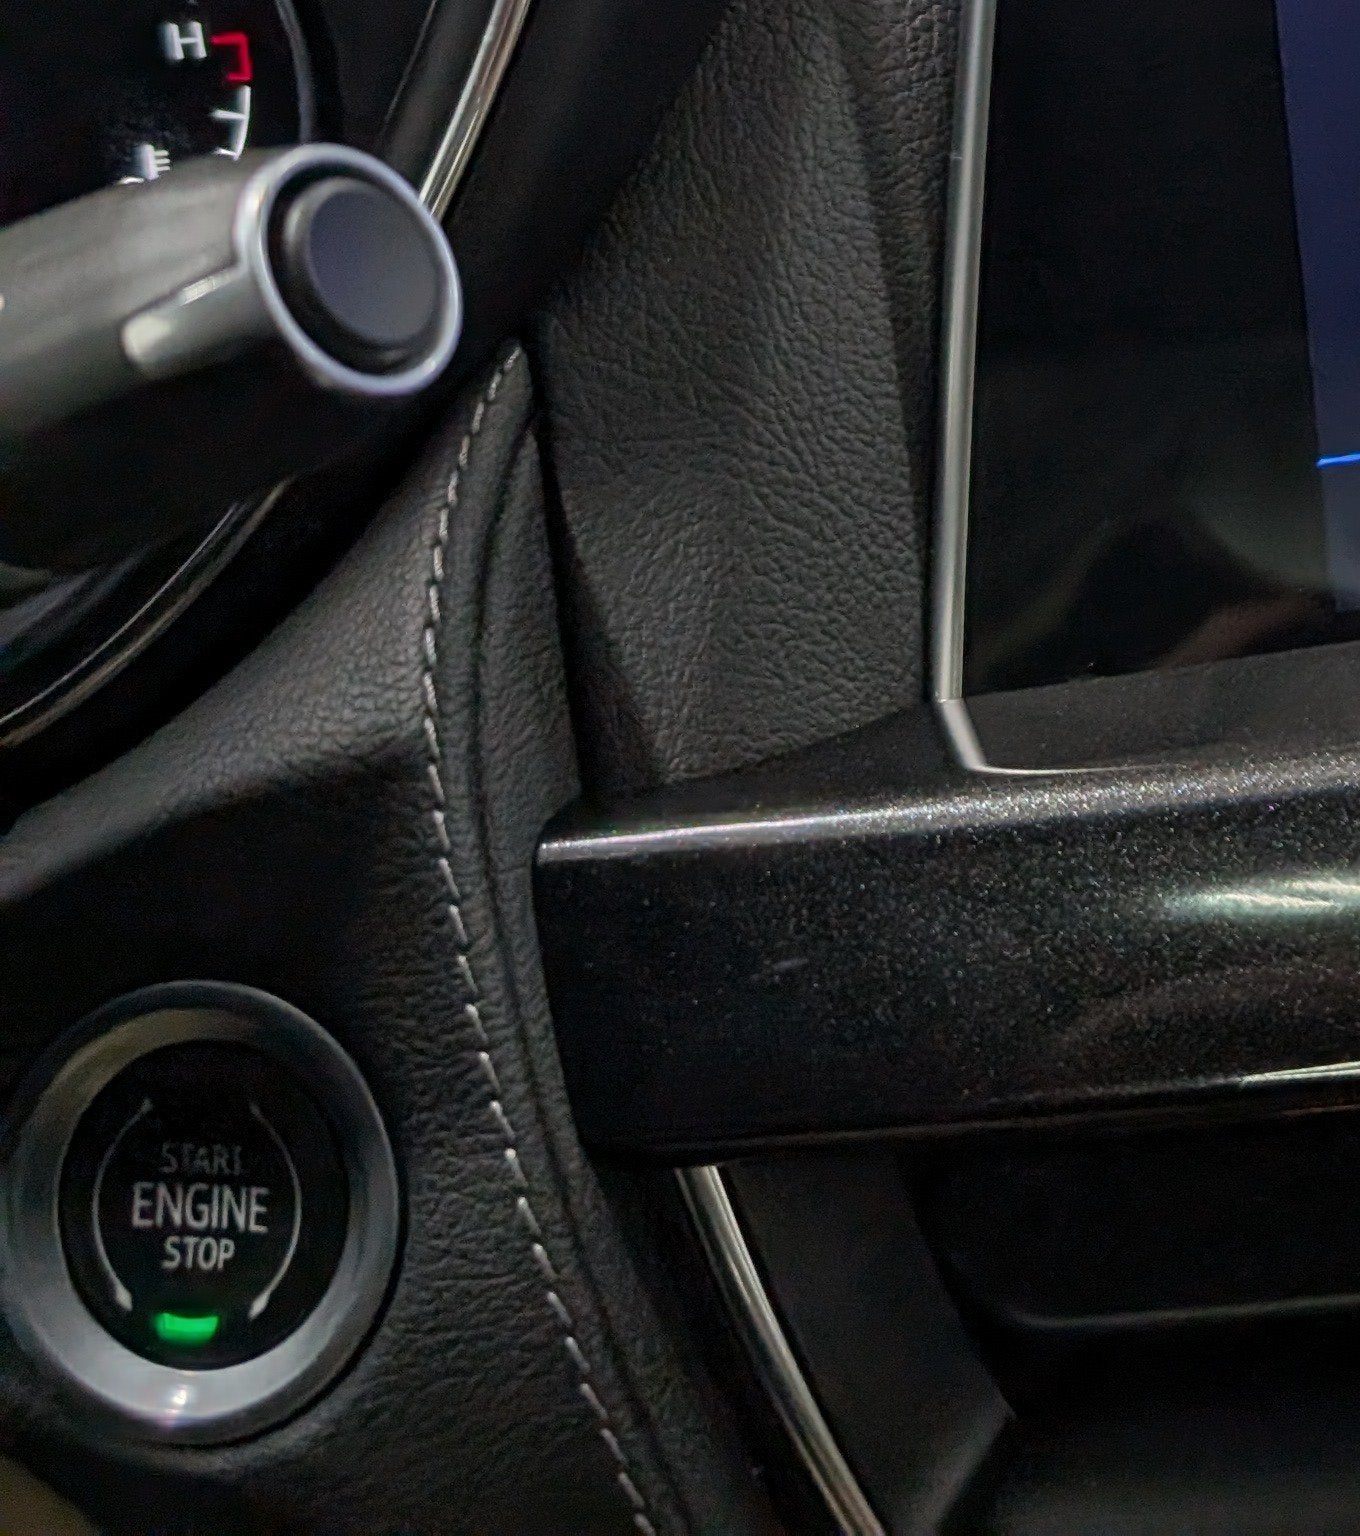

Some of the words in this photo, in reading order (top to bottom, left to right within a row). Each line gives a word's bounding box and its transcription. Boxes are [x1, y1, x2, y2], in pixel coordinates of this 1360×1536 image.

[165, 21, 207, 62] H
[131, 1181, 270, 1234] ENGINE
[163, 1236, 236, 1271] STOP
